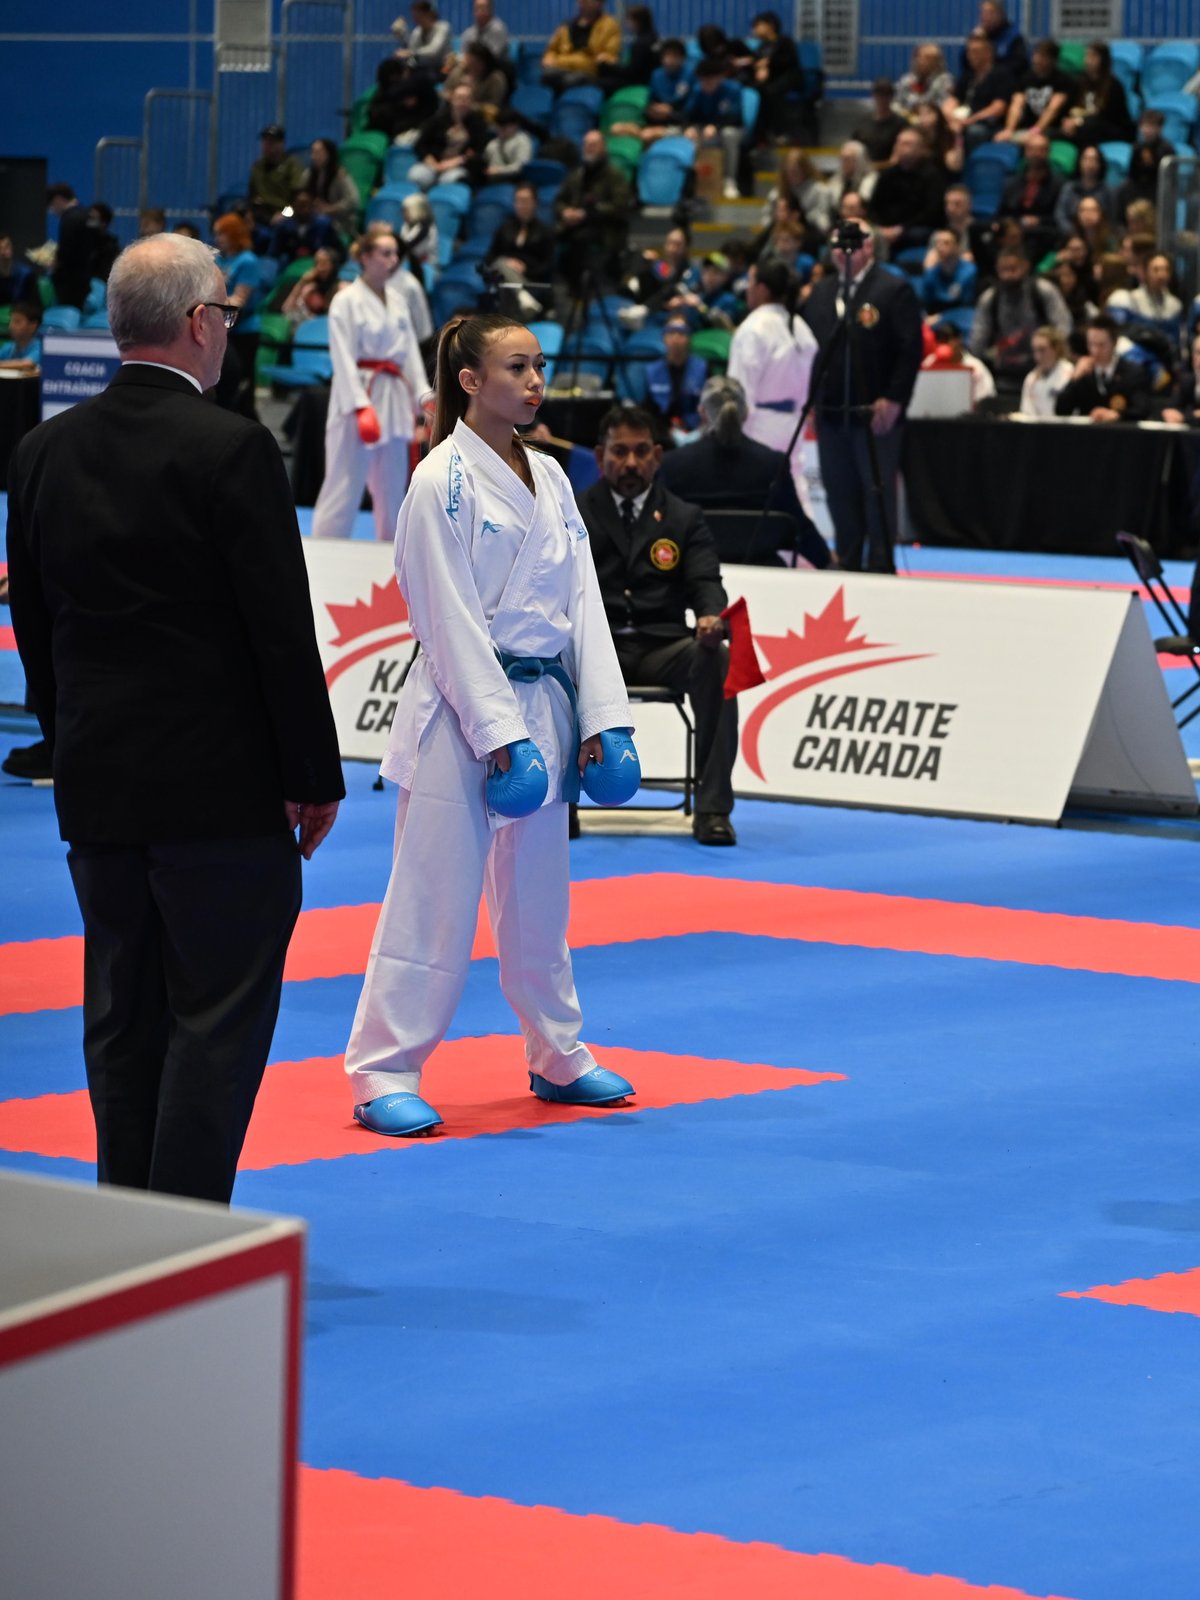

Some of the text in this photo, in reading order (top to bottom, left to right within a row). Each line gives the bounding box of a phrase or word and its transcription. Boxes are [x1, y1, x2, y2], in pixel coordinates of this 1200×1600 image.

[64, 361, 106, 377] COACH
[806, 693, 958, 739] KARATE
[792, 735, 942, 781] CANADA
